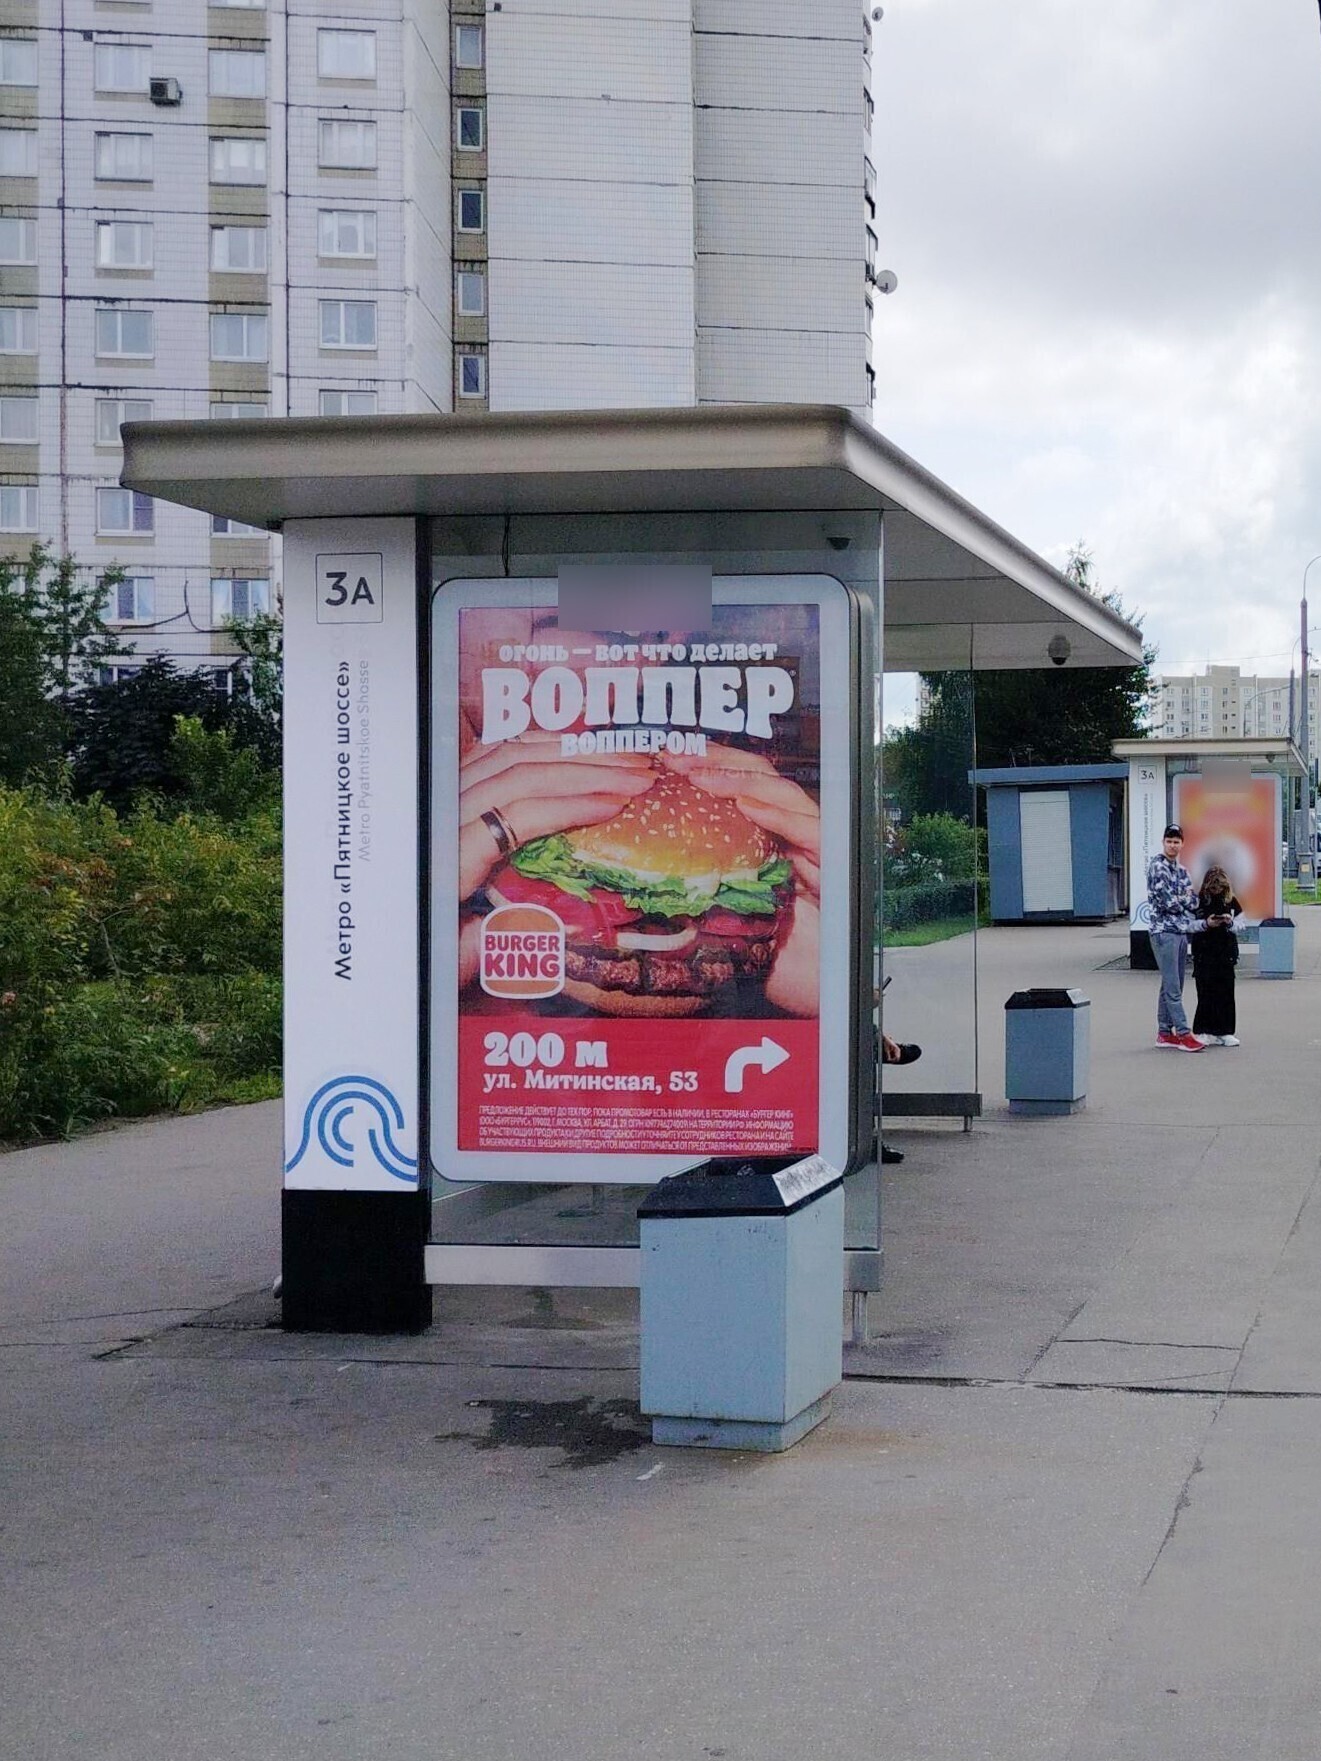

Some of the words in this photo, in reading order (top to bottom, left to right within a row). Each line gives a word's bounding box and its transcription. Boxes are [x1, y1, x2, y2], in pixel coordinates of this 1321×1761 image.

[324, 571, 375, 608] 3А
[499, 645, 569, 662] огонь
[595, 644, 639, 661] вот
[642, 643, 683, 661] что
[689, 642, 778, 663] делает
[337, 660, 351, 745] шоссе»
[358, 660, 370, 714] Shosse
[560, 730, 707, 757] ВОППЕРОМ
[358, 718, 373, 809] Pyatnitskoe
[333, 751, 354, 894] «Пятницкое
[358, 812, 371, 862] Metro
[334, 901, 356, 980] Метро
[485, 934, 560, 952] BURGER
[485, 953, 560, 978] KING
[483, 1031, 565, 1067] 200
[574, 1040, 609, 1068] м
[482, 1072, 517, 1094] ул.
[524, 1069, 662, 1095] Митинская,
[668, 1071, 699, 1092] 53
